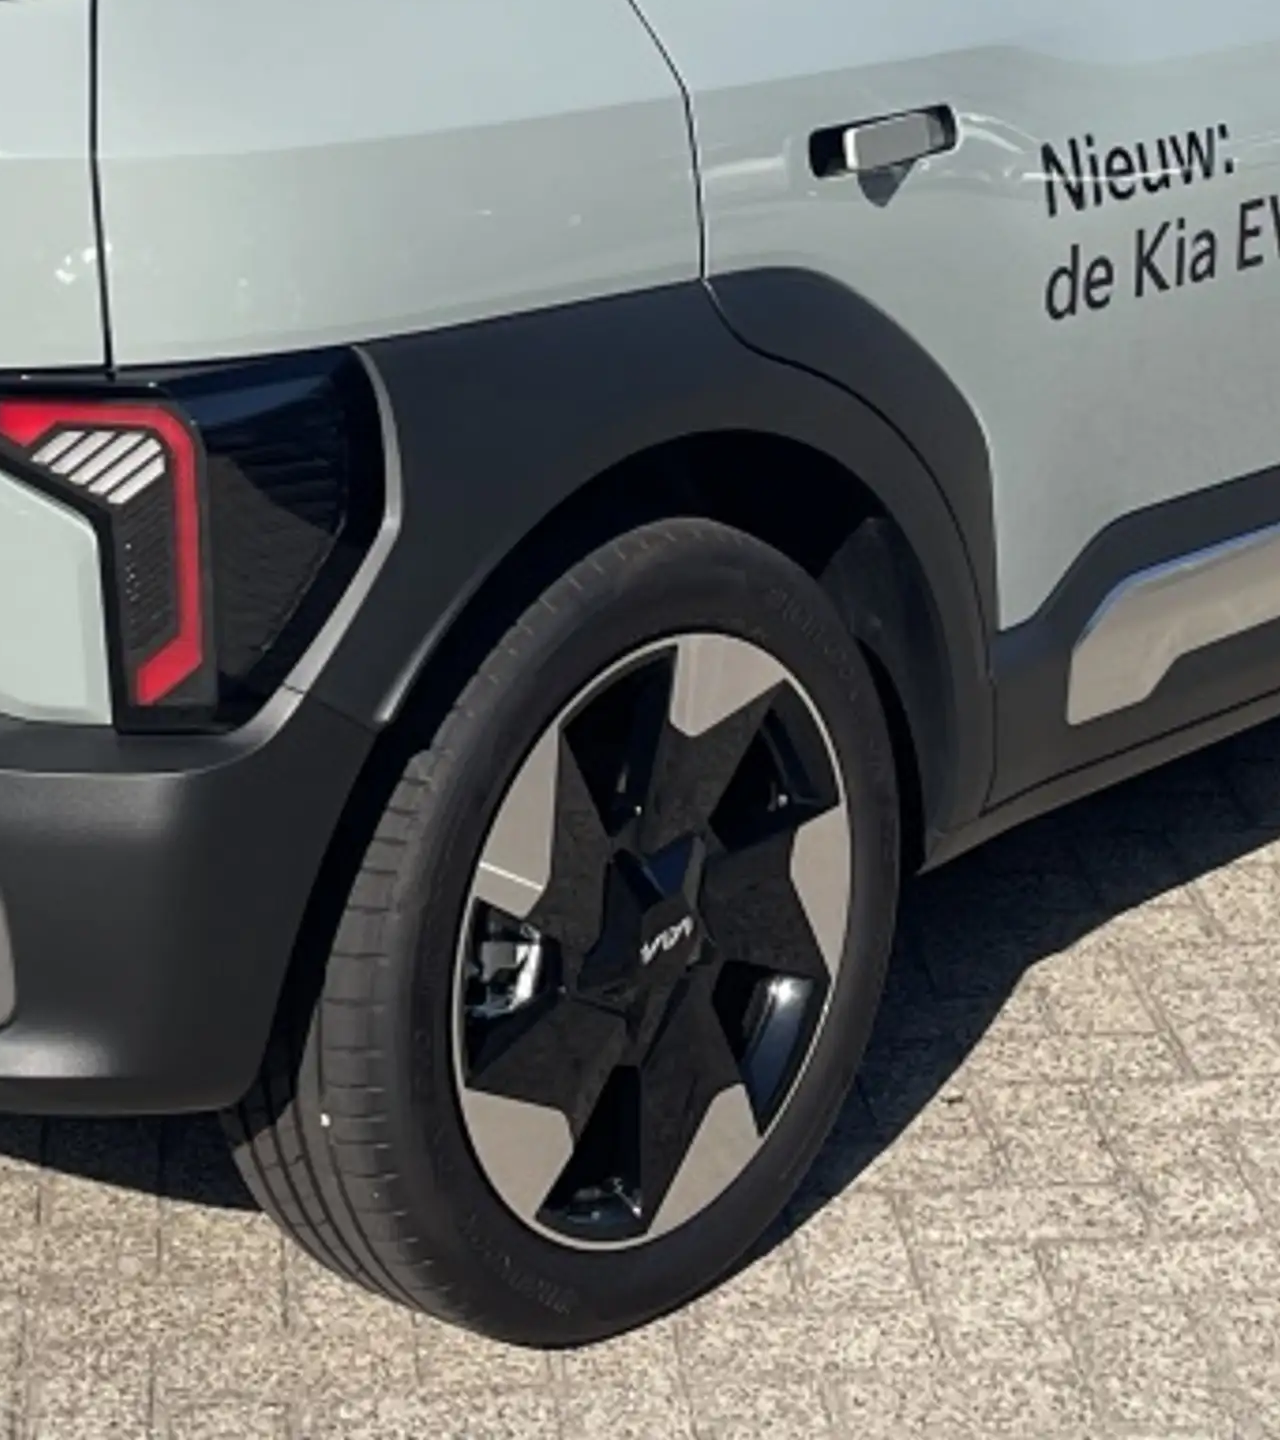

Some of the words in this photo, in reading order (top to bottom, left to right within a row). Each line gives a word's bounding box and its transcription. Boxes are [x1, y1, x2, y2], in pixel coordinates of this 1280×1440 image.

[1040, 124, 1235, 217] Nieuw:
[1044, 243, 1115, 321] de
[1133, 216, 1218, 298] Kia
